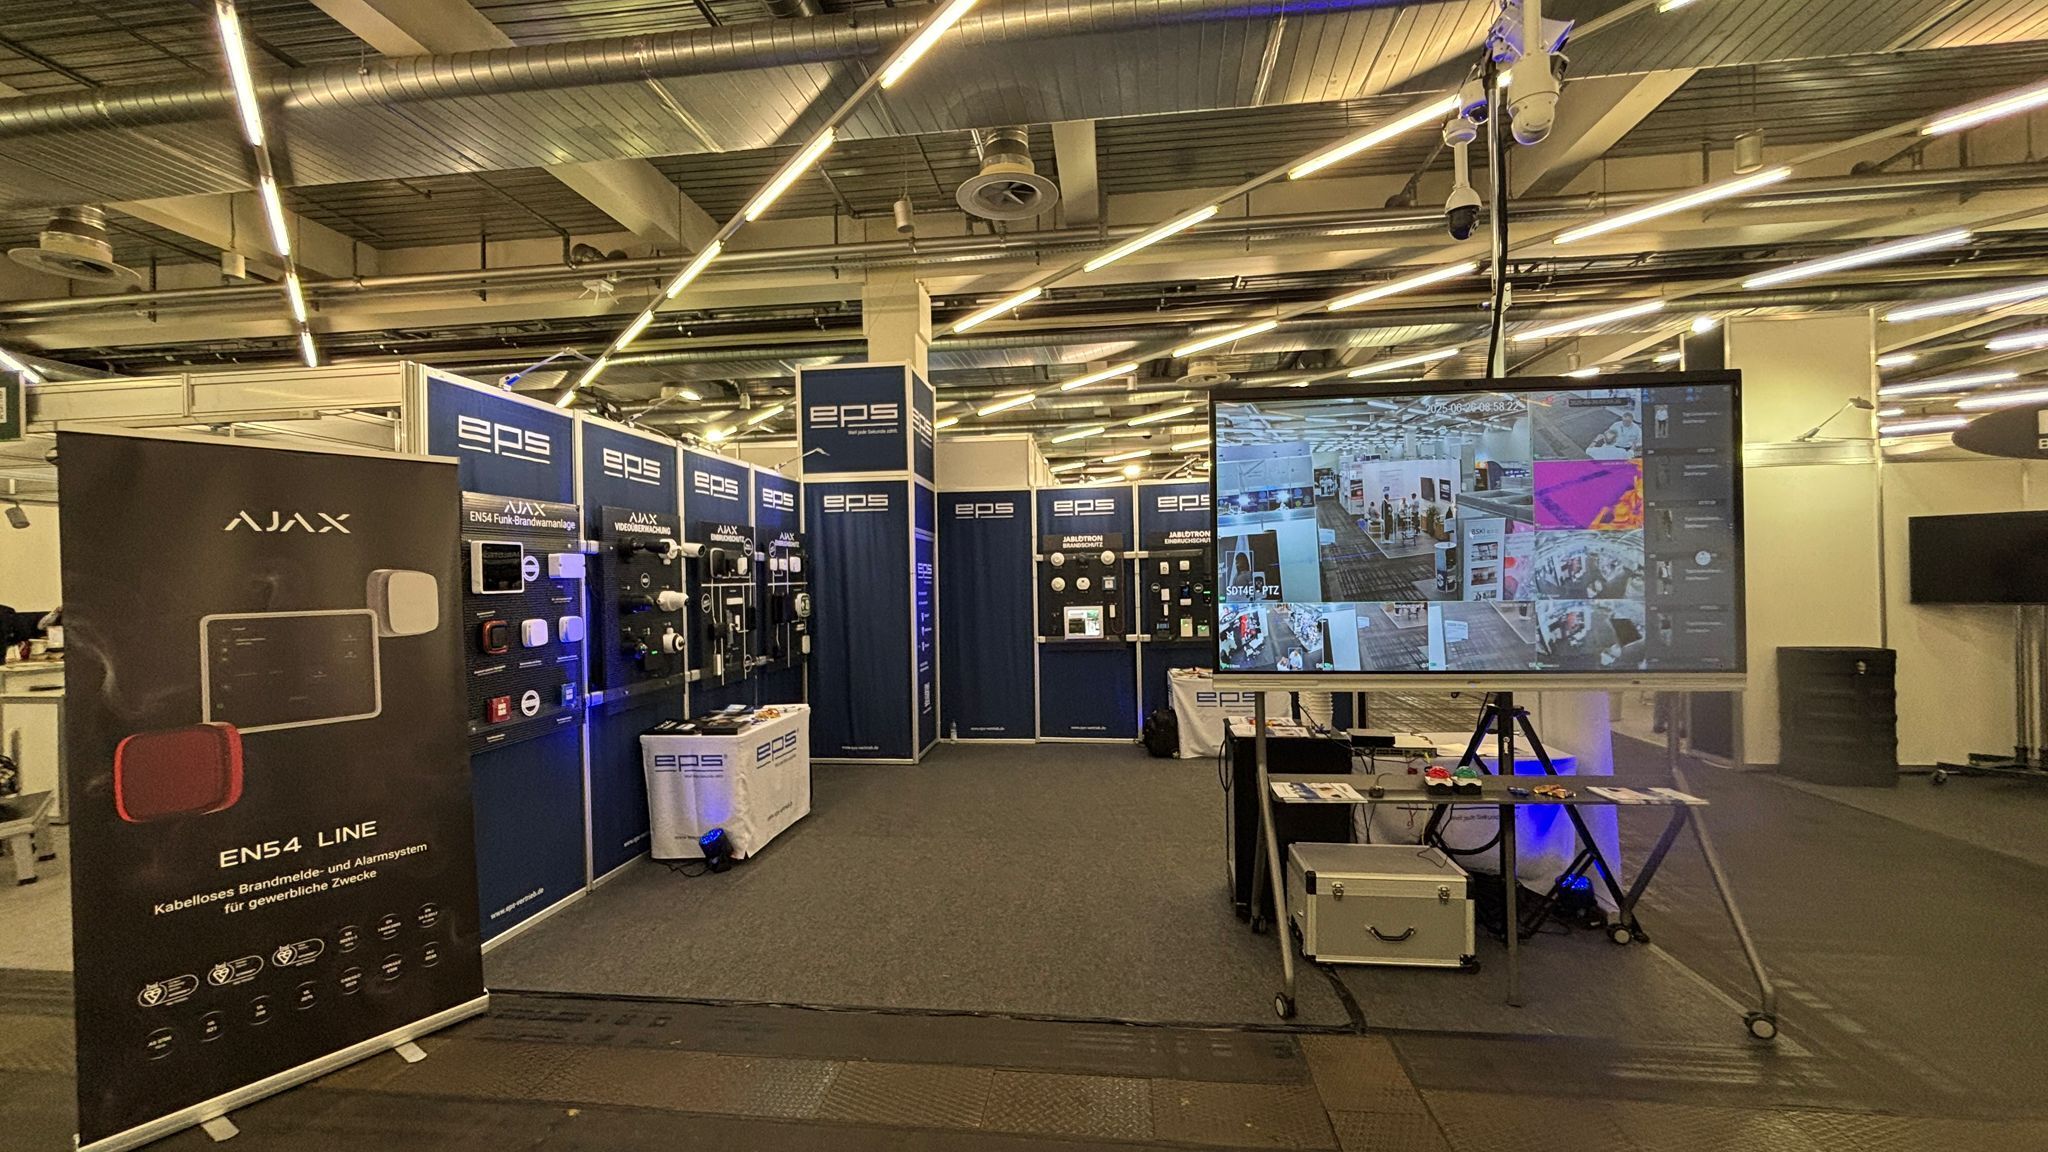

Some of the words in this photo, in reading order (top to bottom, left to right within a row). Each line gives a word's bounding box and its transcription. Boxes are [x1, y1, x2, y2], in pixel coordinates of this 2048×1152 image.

[810, 404, 898, 428] eps
[458, 415, 550, 464] eps
[603, 448, 660, 485] eps
[694, 470, 739, 501] eps
[504, 501, 546, 517] AJAX
[762, 488, 794, 512] eps
[824, 495, 888, 512] eps
[1054, 499, 1115, 516] eps
[629, 512, 657, 525] AJAX
[955, 503, 1014, 519] eps
[224, 510, 351, 534] AJAX
[470, 511, 492, 523] EN54
[494, 514, 576, 531] Funk-Brandwarnanlage
[614, 522, 671, 536] VIDEOÜBERWACHUNG
[717, 525, 738, 535] AJAX
[780, 532, 795, 541] AJAX
[1063, 535, 1103, 543] JABLOTRON
[1169, 531, 1211, 539] JABLOTRON
[1226, 586, 1254, 595] SDT4E
[1262, 586, 1279, 595] PTZ
[757, 730, 797, 770] eps
[655, 754, 724, 772] eps
[220, 836, 302, 868] EN54
[318, 820, 378, 848] LINE
[154, 886, 235, 915] Kabelloses
[239, 868, 325, 895] Brandmelde-
[328, 860, 351, 874] und
[354, 843, 428, 867] Alarmsystem
[224, 902, 244, 914] für
[249, 881, 329, 911] gewerbliche
[332, 869, 377, 888] Zwecke
